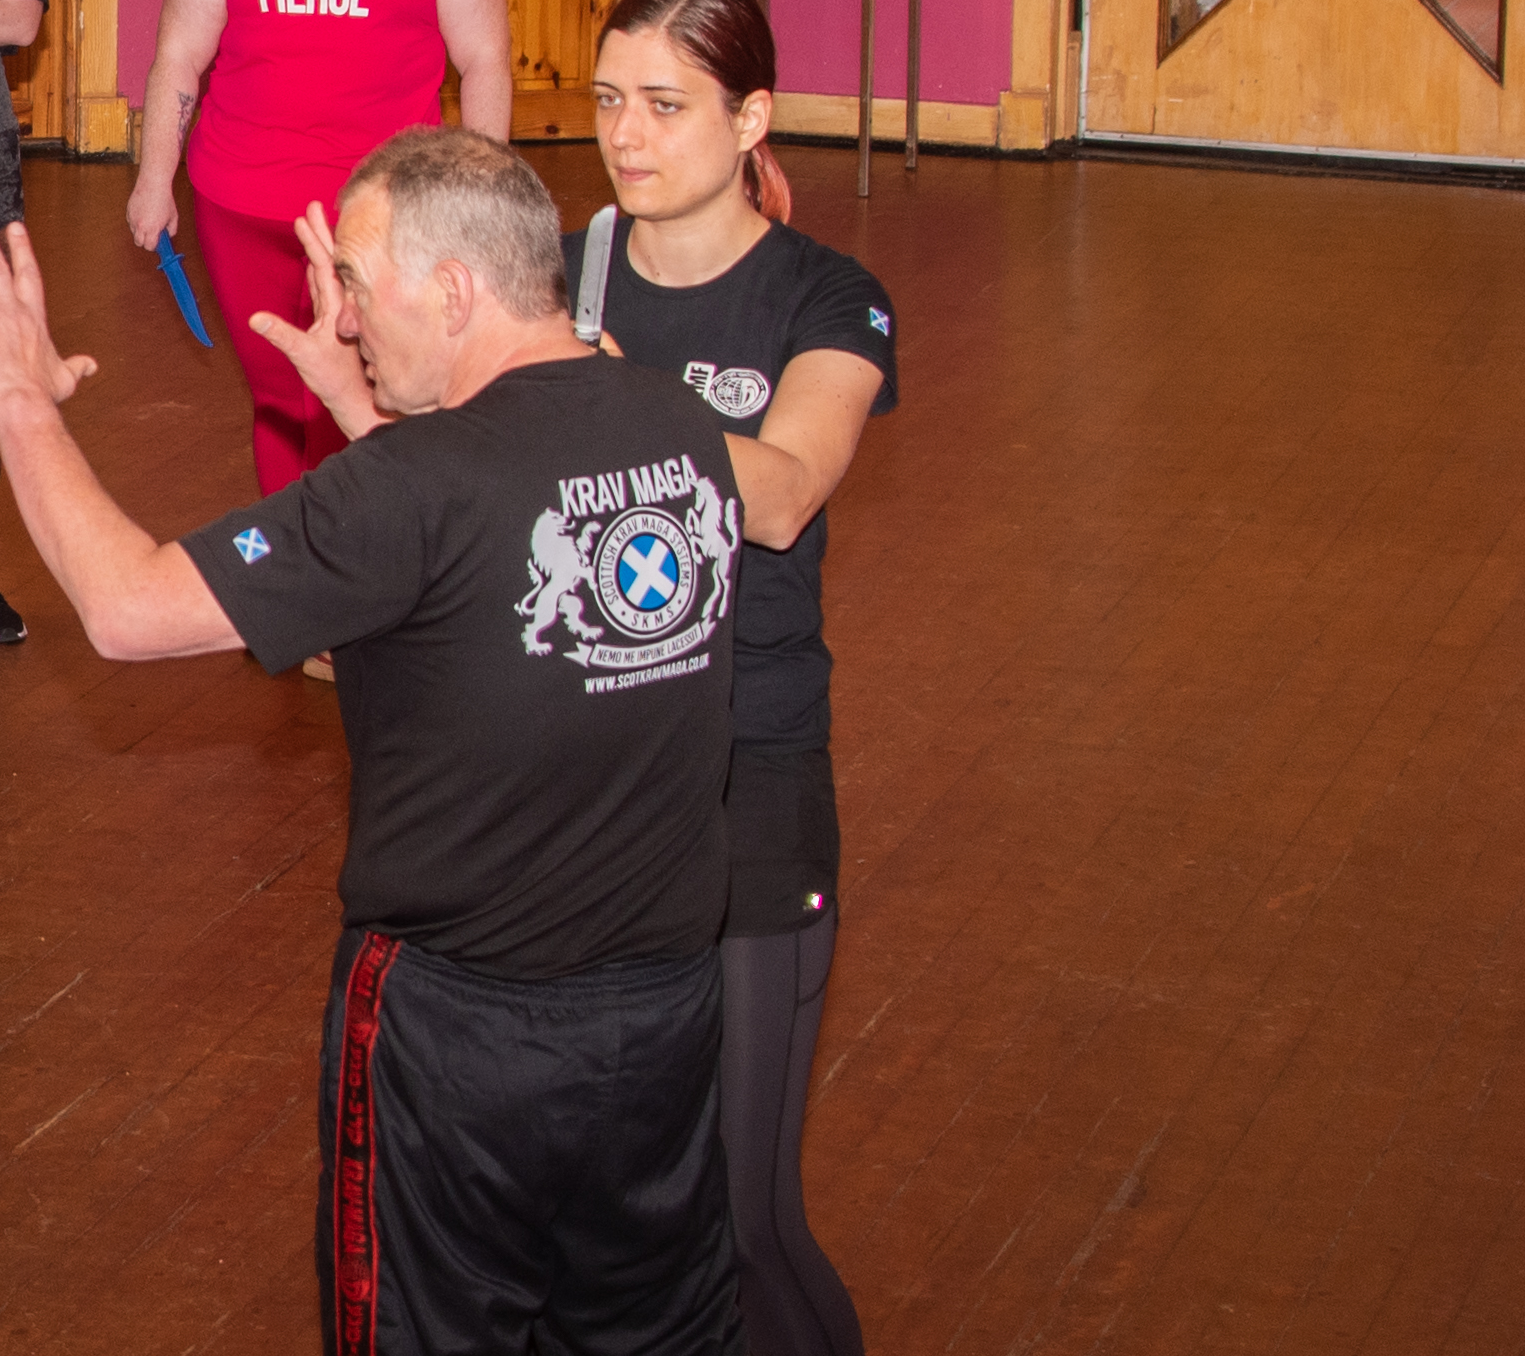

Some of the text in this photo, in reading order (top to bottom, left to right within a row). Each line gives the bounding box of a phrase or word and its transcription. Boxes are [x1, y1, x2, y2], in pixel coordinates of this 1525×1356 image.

[558, 454, 699, 519] KRAV MAGA
[601, 515, 690, 606] SCOTTISH KRAV MAGA SYSTEMS
[596, 628, 699, 663] NEMO ME IMPUNE LACESSIT
[584, 653, 710, 693] WWW.SCOTKRAVMAGA.CO.UK
